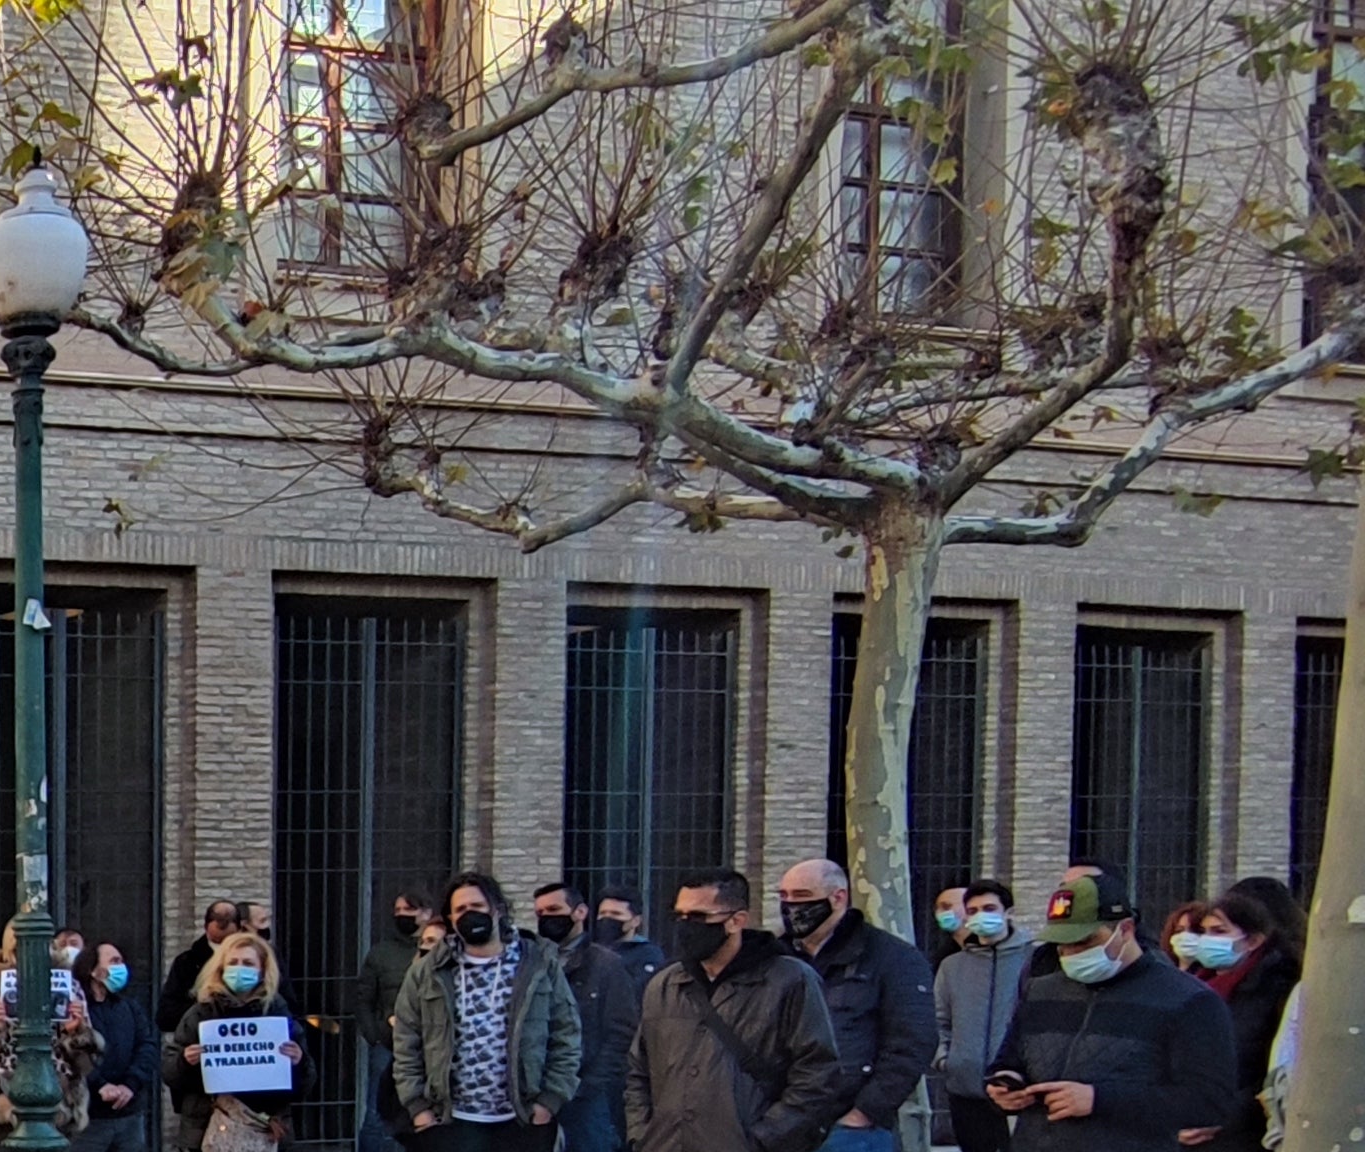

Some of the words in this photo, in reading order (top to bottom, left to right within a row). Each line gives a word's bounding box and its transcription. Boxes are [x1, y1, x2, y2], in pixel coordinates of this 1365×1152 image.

[218, 1022, 258, 1037] OCIO
[203, 1044, 221, 1054] SIN
[224, 1042, 275, 1053] DERECHO
[204, 1058, 212, 1067] A
[215, 1055, 276, 1067] TRABAJAR
